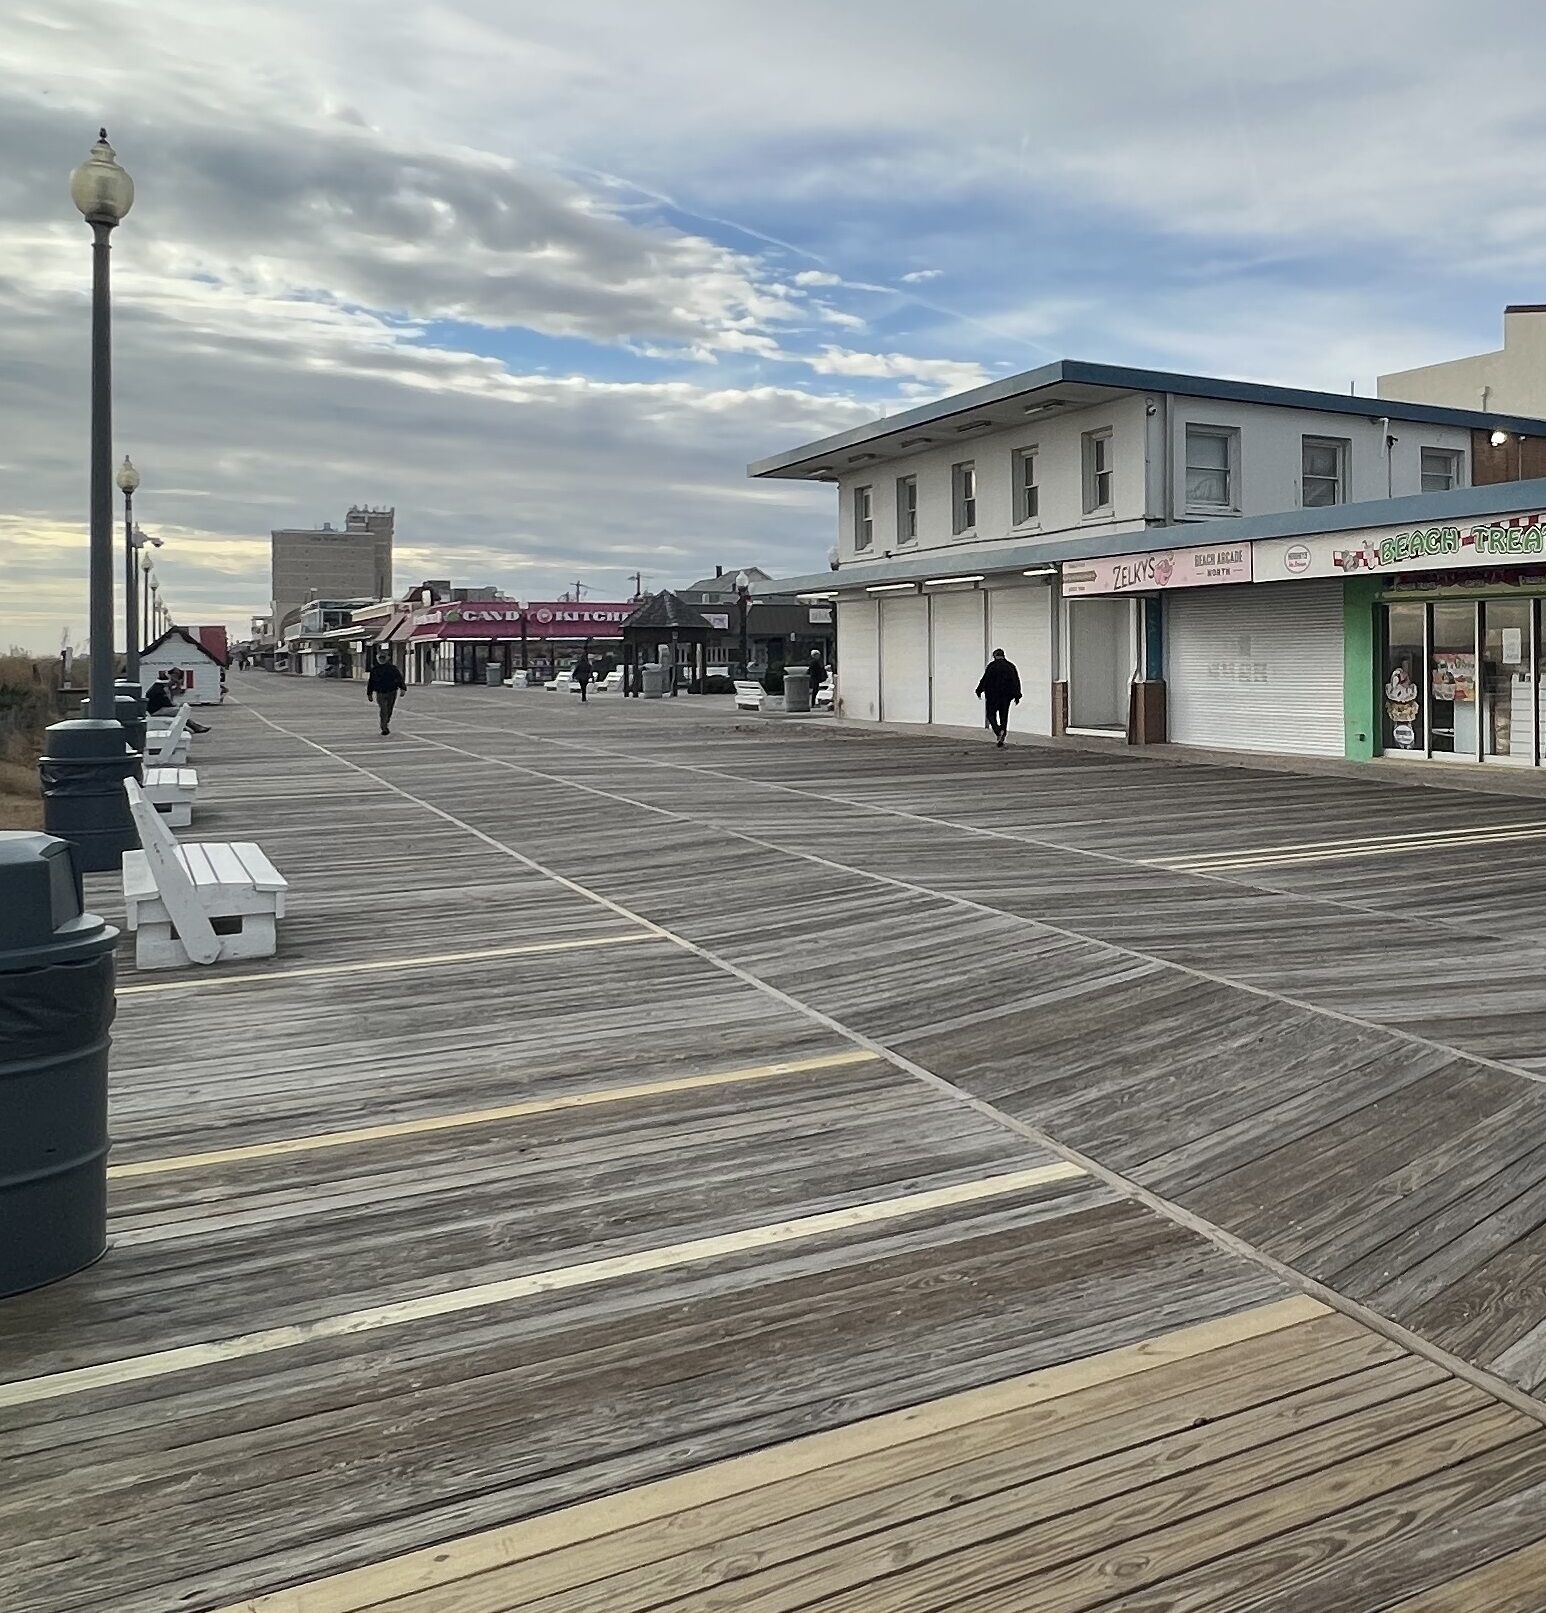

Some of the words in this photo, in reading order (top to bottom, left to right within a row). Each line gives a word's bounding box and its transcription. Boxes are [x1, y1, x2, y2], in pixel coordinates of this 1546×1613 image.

[1379, 526, 1460, 566] BEACH
[1194, 553, 1215, 567] BEACH
[1217, 550, 1243, 565] ARCADE
[1207, 568, 1231, 577] NORTH
